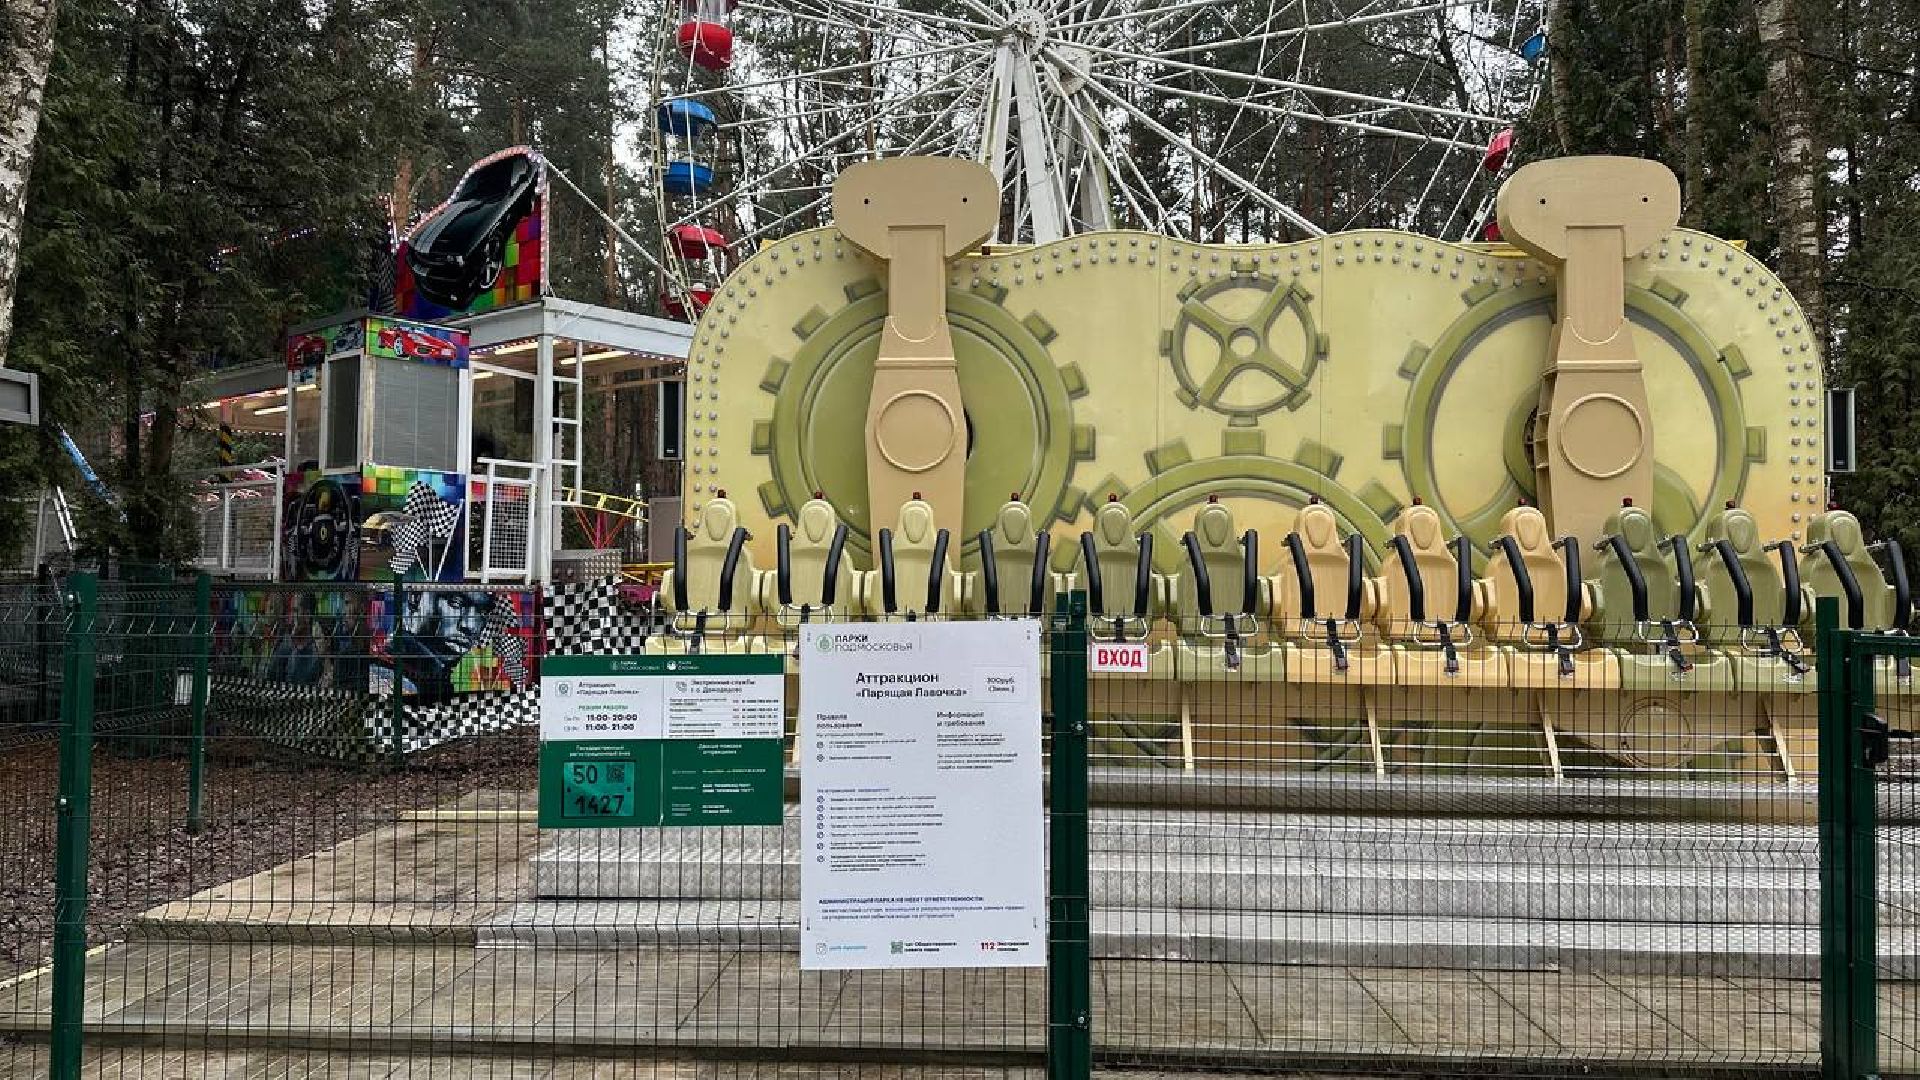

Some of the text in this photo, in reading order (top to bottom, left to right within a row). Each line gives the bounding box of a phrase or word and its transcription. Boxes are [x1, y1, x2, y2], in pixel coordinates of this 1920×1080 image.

[835, 635, 868, 643] ПАРКИ
[835, 643, 912, 652] ПОДМОСКОВЬЯ
[1098, 649, 1142, 668] ВХОД
[856, 672, 940, 685] Аттракцион
[856, 686, 967, 699] «Парящая Лавочка»
[573, 764, 598, 784] 50
[575, 794, 625, 814] 1427
[980, 941, 995, 950] 112
